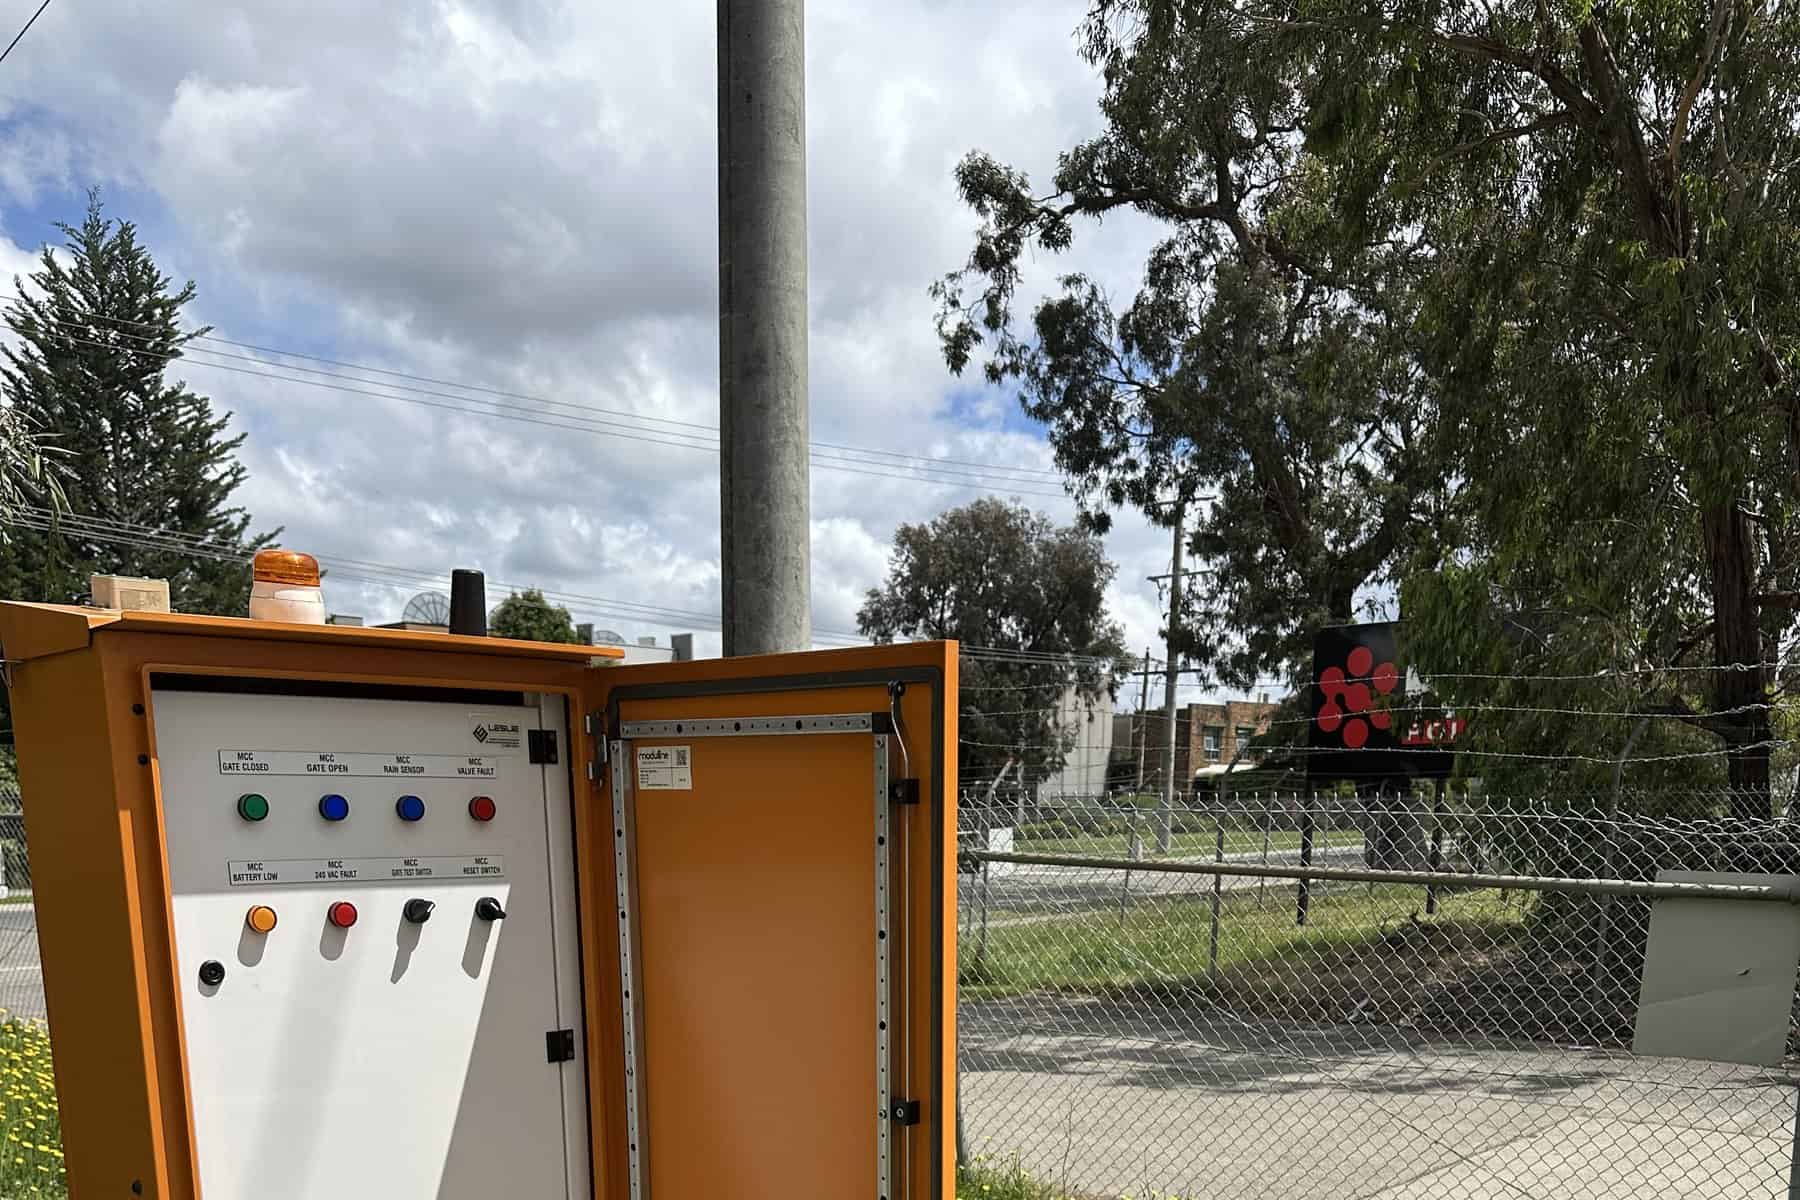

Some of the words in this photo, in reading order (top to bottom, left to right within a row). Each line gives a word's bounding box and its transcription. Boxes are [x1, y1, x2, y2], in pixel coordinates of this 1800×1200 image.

[237, 752, 254, 761] MCC
[319, 754, 335, 763] MCC
[396, 756, 411, 764] MCC
[468, 758, 483, 766] MCC
[222, 762, 240, 771] GATE
[242, 762, 269, 772] CLOSED
[306, 763, 326, 773] GATE
[328, 764, 348, 773] OPEN
[383, 765, 399, 774] RAIN
[400, 766, 425, 775] SENSOR
[457, 767, 475, 776] VALVE
[476, 767, 495, 776] FAULT
[327, 860, 343, 869] MCC
[474, 857, 489, 865] MCC
[247, 862, 264, 872] MCC
[463, 866, 480, 875] RESET
[481, 866, 501, 874] SWITCH
[233, 873, 261, 882] BATTERY
[263, 872, 278, 881] LOW
[327, 870, 339, 879] VAC
[340, 870, 358, 879] FAULT
